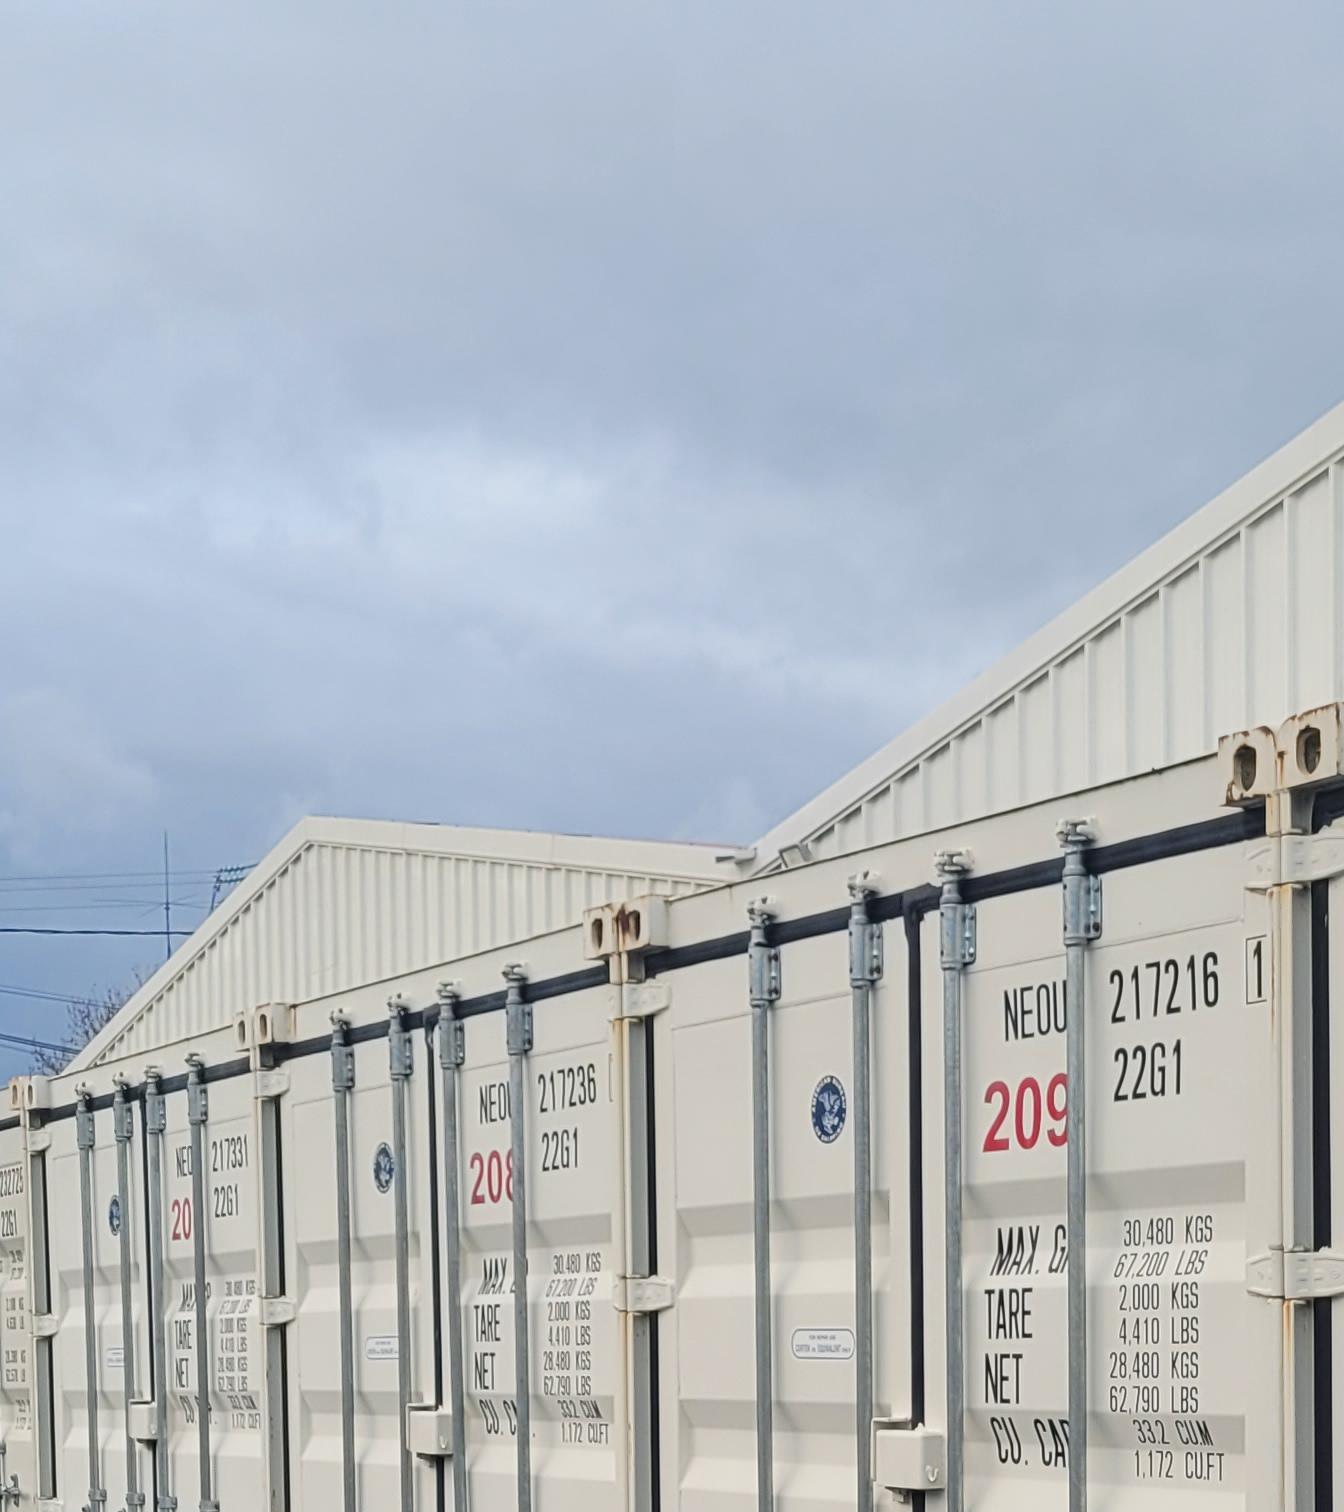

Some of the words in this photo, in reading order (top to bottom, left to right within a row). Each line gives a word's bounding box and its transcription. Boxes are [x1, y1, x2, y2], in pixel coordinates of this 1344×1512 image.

[1004, 979, 1067, 1042] NEOU
[1109, 951, 1219, 1024] 217216
[1253, 939, 1262, 999] 1
[538, 1063, 597, 1114] 217236
[1113, 1038, 1182, 1102] 22G1
[982, 1072, 1069, 1153] 209
[176, 1145, 193, 1178] NEO
[212, 1133, 248, 1172] 217331
[541, 1126, 578, 1172] 22G1
[172, 1197, 192, 1241] 20
[214, 1183, 239, 1218] 22G1
[1123, 1217, 1174, 1247] 30,480
[1185, 1214, 1213, 1244] KGS
[989, 1225, 1040, 1277] MAX.
[1174, 1249, 1208, 1275] LBS
[984, 1287, 1033, 1340] TARE
[1118, 1283, 1160, 1312] 2,000
[1170, 1281, 1199, 1310] KGS
[473, 1304, 501, 1342] TARE
[1118, 1317, 1160, 1346] 4,410
[1171, 1316, 1199, 1344] LBS
[176, 1358, 189, 1388] NET
[474, 1352, 496, 1390] NET
[984, 1353, 1023, 1405] NET
[1109, 1352, 1160, 1381] 28,480
[1170, 1351, 1199, 1380] KGS
[479, 1399, 504, 1435] CU.
[1109, 1385, 1160, 1416] 62,790
[1171, 1386, 1199, 1414] LBS
[989, 1416, 1028, 1466] CU.
[1132, 1419, 1170, 1445] 33.2
[1174, 1419, 1214, 1447] CU.M
[1184, 1452, 1225, 1482] CU.FT
